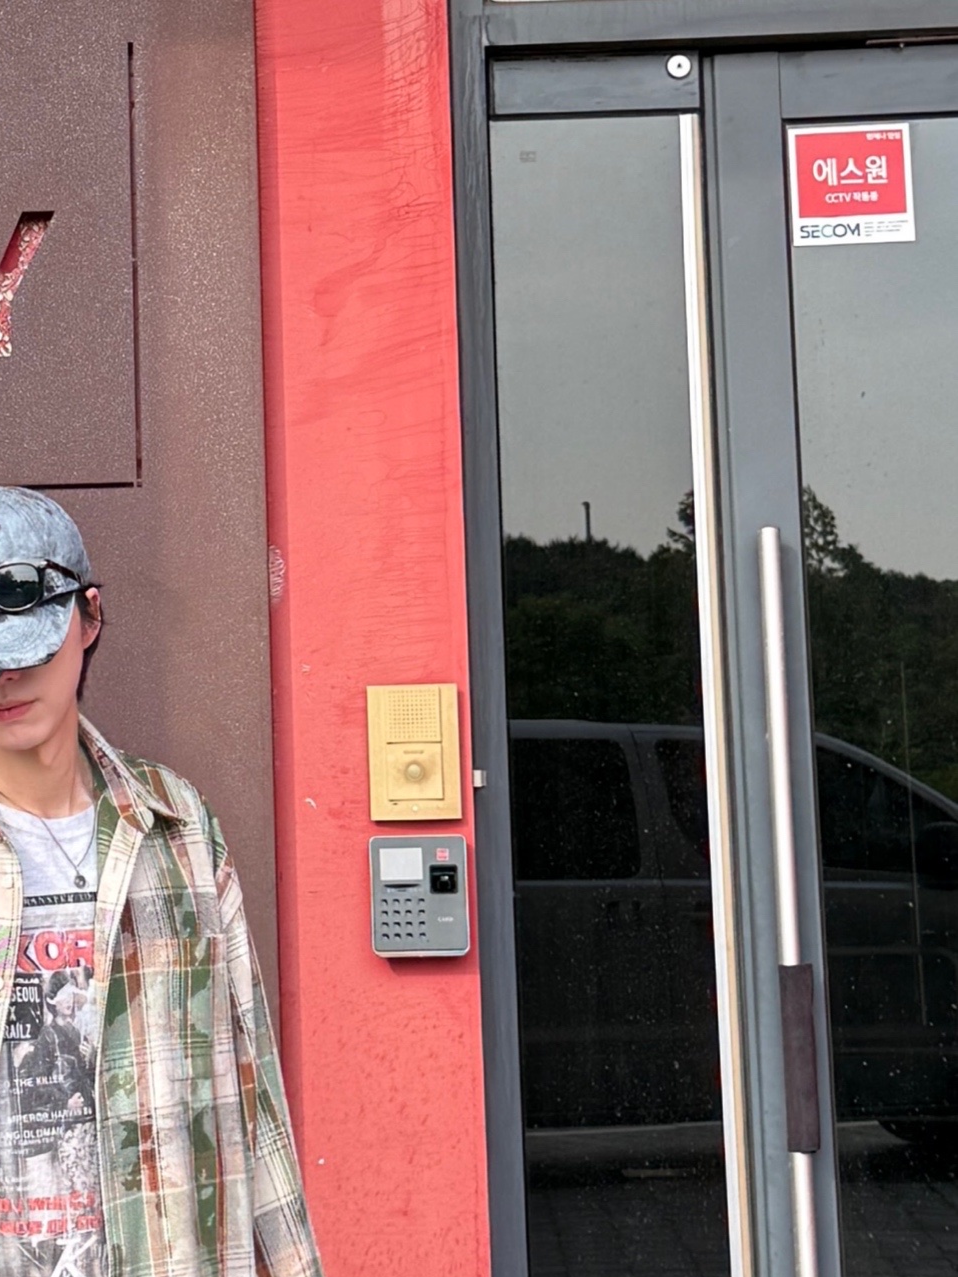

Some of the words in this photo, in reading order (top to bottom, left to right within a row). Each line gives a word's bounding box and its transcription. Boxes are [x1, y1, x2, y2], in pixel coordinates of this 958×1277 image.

[812, 155, 889, 187] 에스원
[825, 191, 852, 204] CCTV
[799, 223, 861, 239] SECOM
